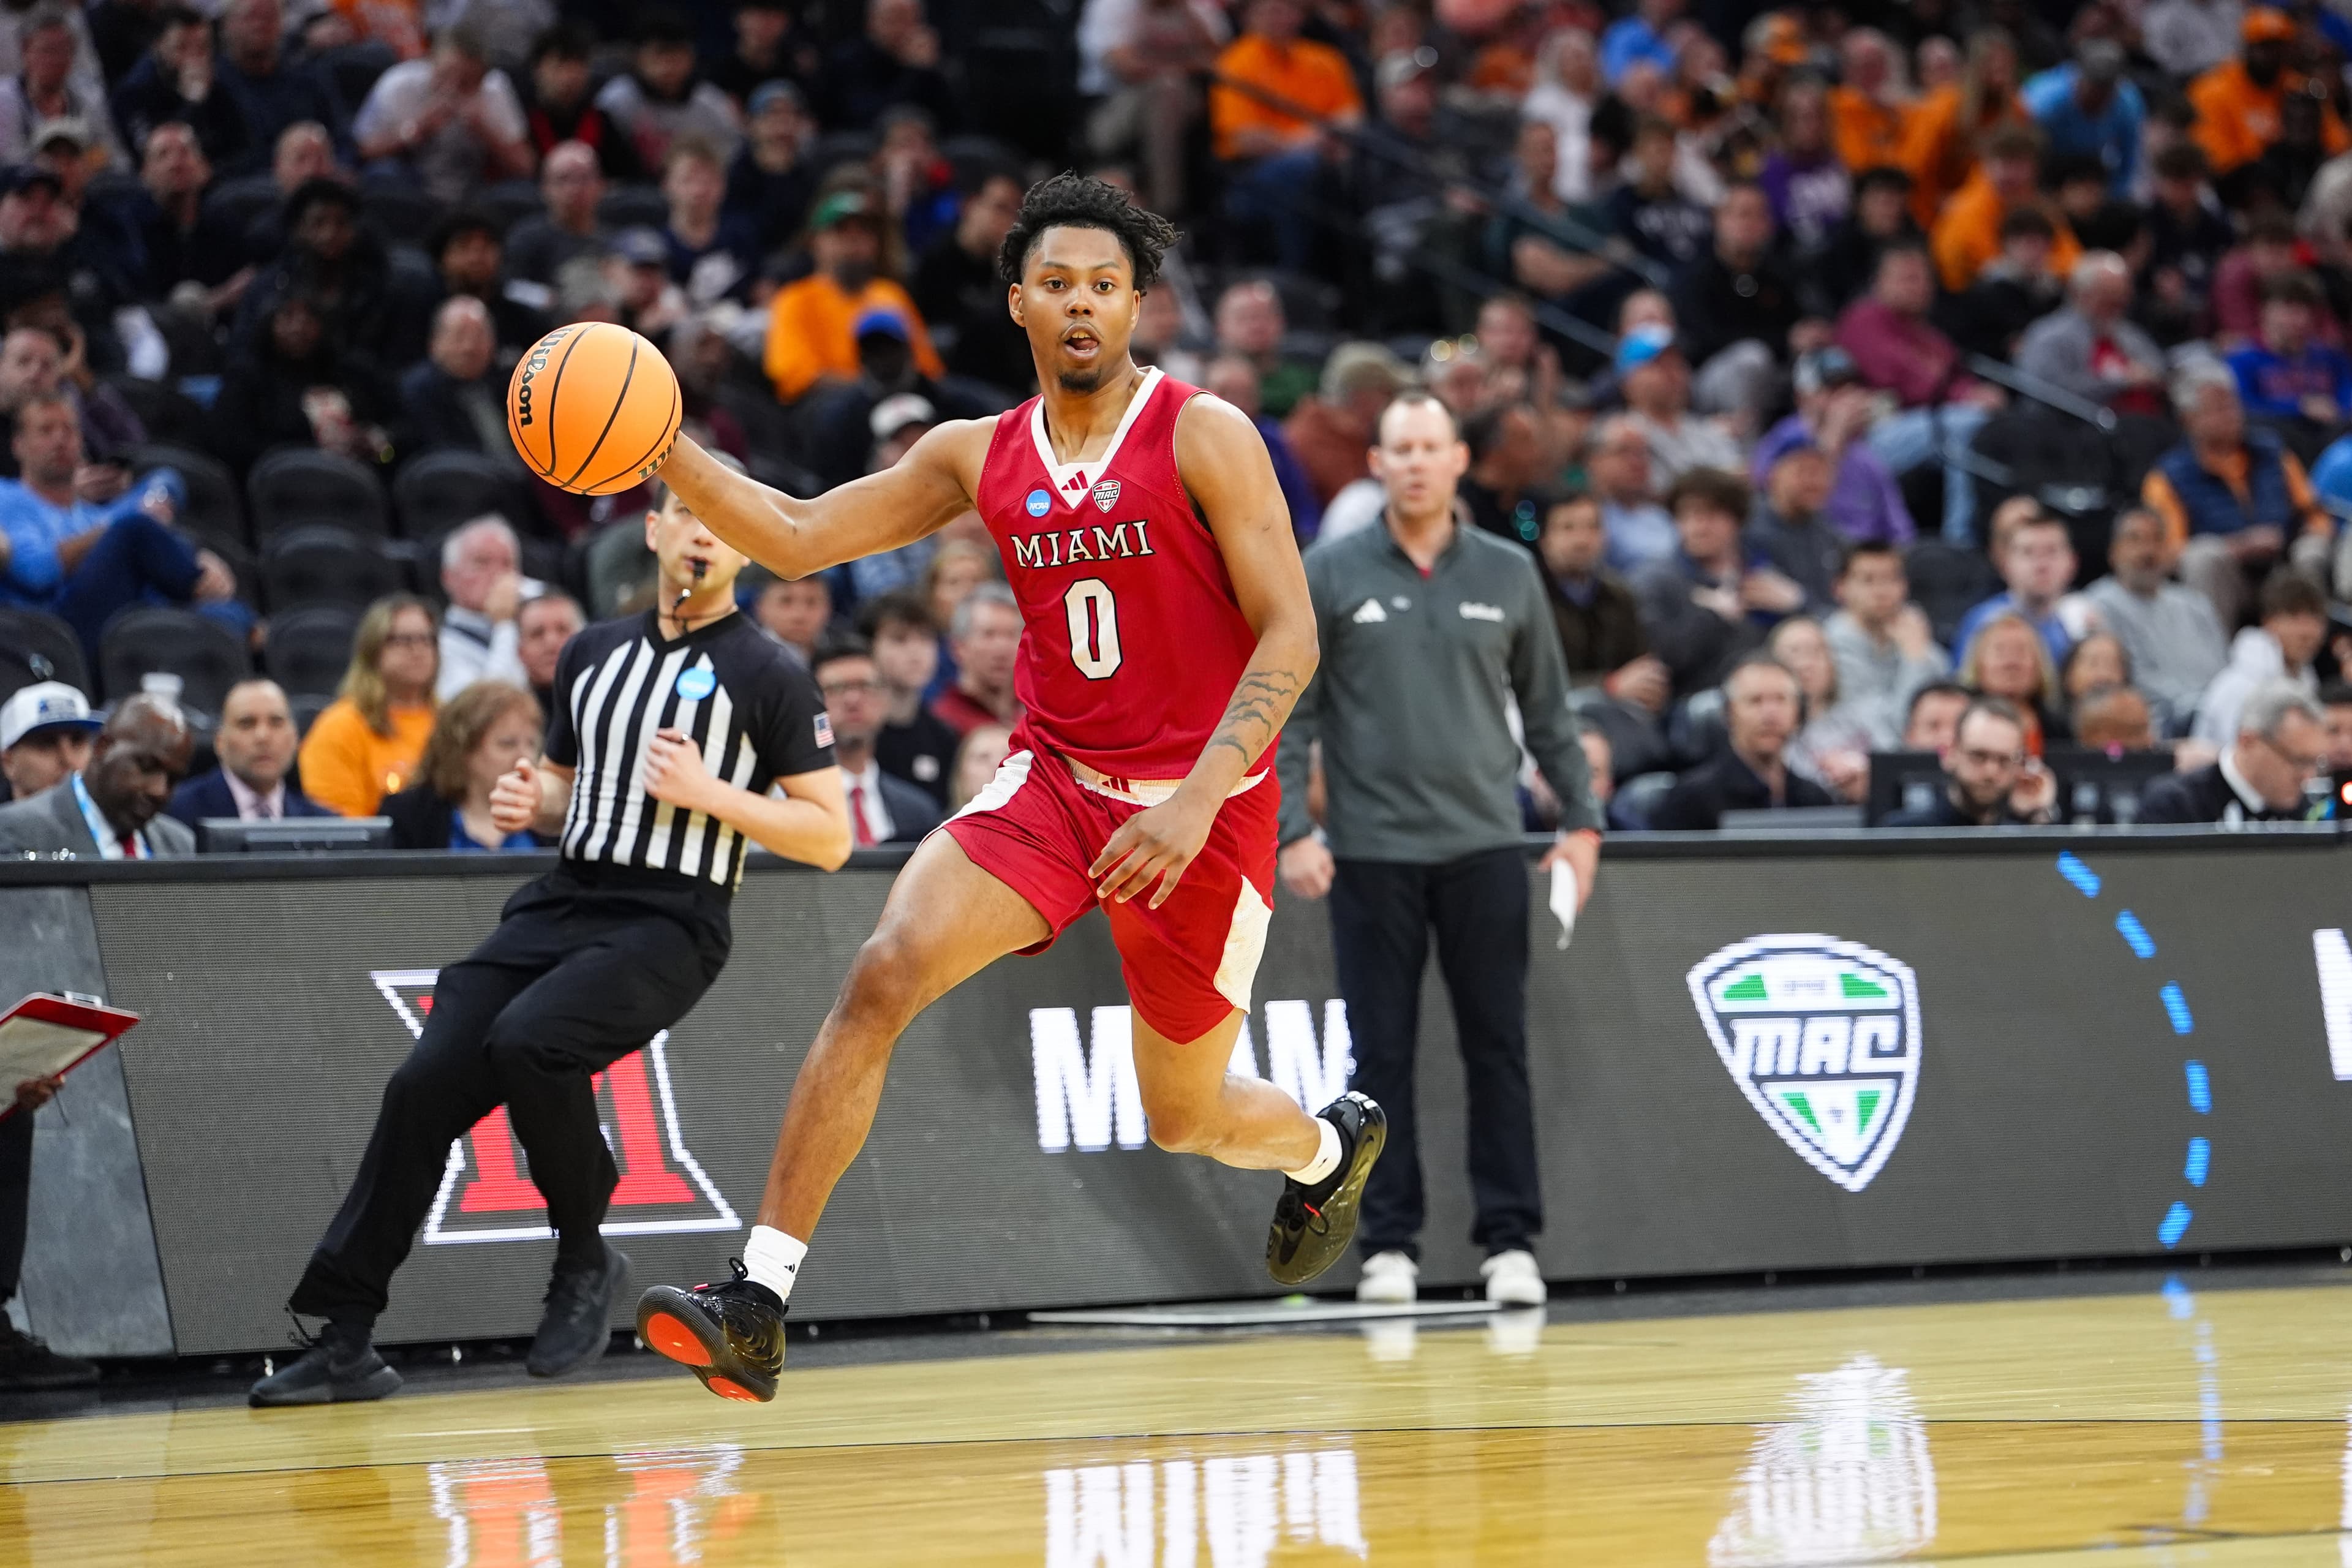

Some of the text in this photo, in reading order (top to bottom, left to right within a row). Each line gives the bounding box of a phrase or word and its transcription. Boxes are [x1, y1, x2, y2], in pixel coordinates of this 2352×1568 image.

[519, 328, 575, 428] Wilson
[1028, 502, 1049, 510] NCAA
[1095, 488, 1118, 501] MAC
[1010, 519, 1156, 568] MIAMI
[1063, 577, 1123, 681] 0
[1730, 1014, 1904, 1076] MAC
